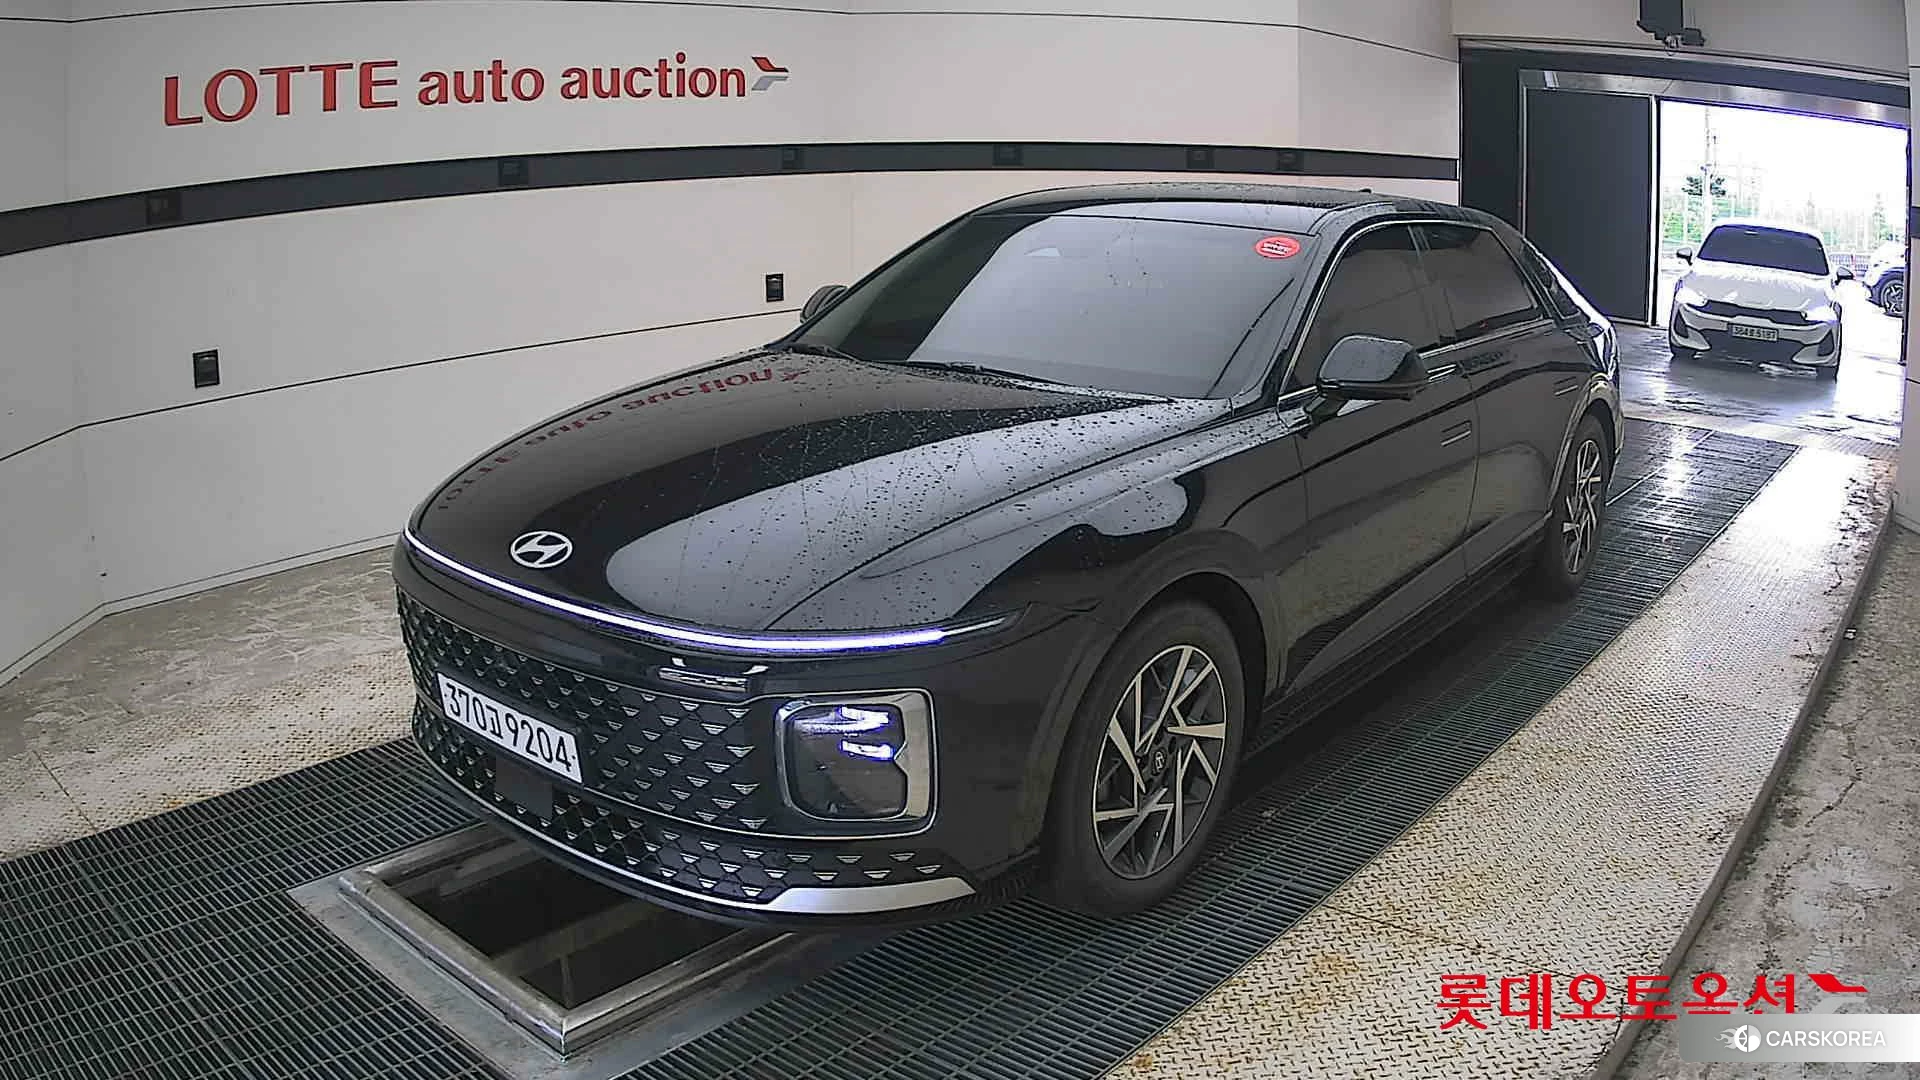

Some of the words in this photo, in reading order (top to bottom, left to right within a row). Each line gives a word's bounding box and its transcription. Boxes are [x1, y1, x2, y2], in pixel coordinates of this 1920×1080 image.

[164, 60, 398, 126] LOTTE
[417, 59, 545, 106] auto
[560, 52, 746, 99] auction
